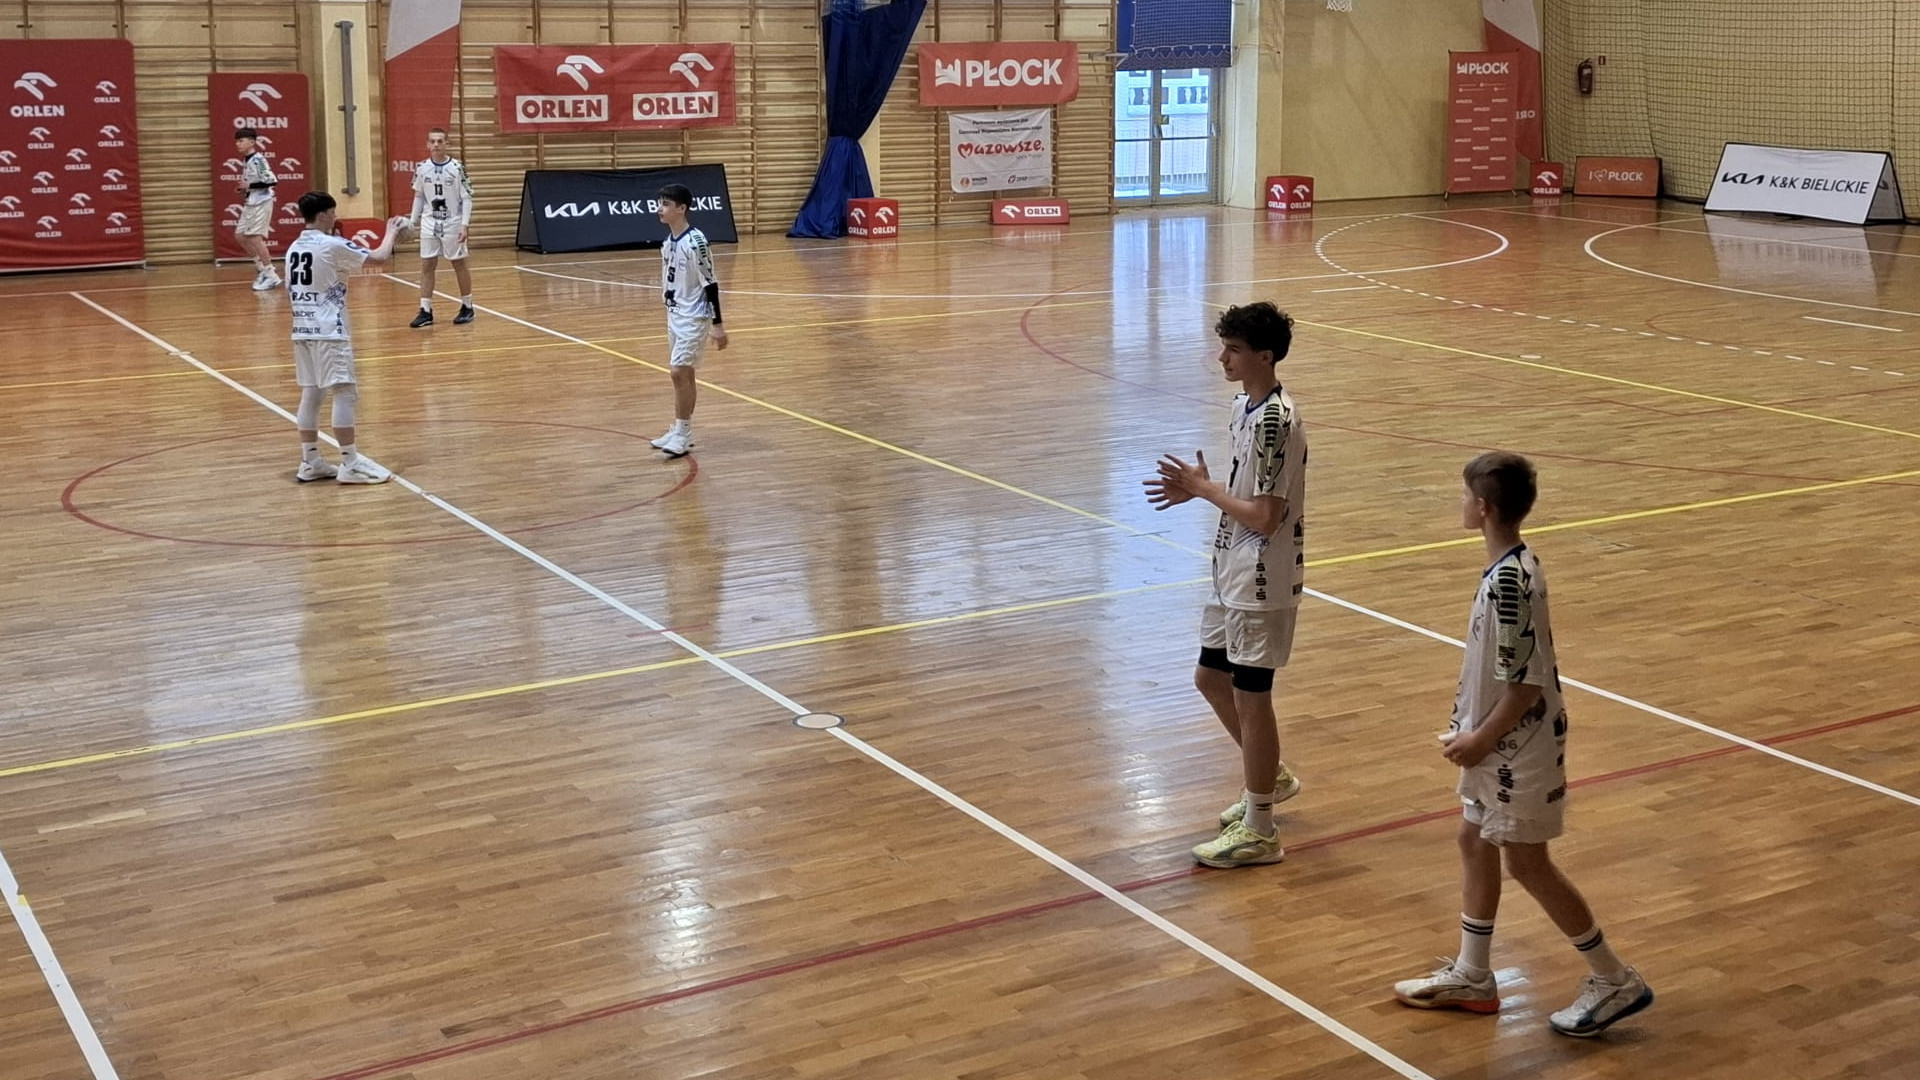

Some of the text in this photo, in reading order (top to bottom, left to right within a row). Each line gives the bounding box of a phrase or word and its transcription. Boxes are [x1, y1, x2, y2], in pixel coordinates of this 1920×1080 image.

[965, 58, 1063, 87] PŁOCK
[1469, 62, 1509, 74] PŁOCK
[10, 105, 65, 117] ORLEN
[521, 99, 602, 119] ORLEN
[638, 95, 713, 116] ORLEN
[233, 117, 289, 128] ORLEN
[391, 160, 416, 173] ORL
[1608, 171, 1643, 181] PŁOCK
[1721, 172, 1870, 194] KIA K&K BIELICKIE
[545, 202, 600, 218] KIA
[608, 199, 644, 215] K&K
[1026, 207, 1060, 215] ORLEN
[848, 226, 868, 236] ORLEN
[872, 226, 896, 235] ORLEN
[290, 252, 313, 286] 23
